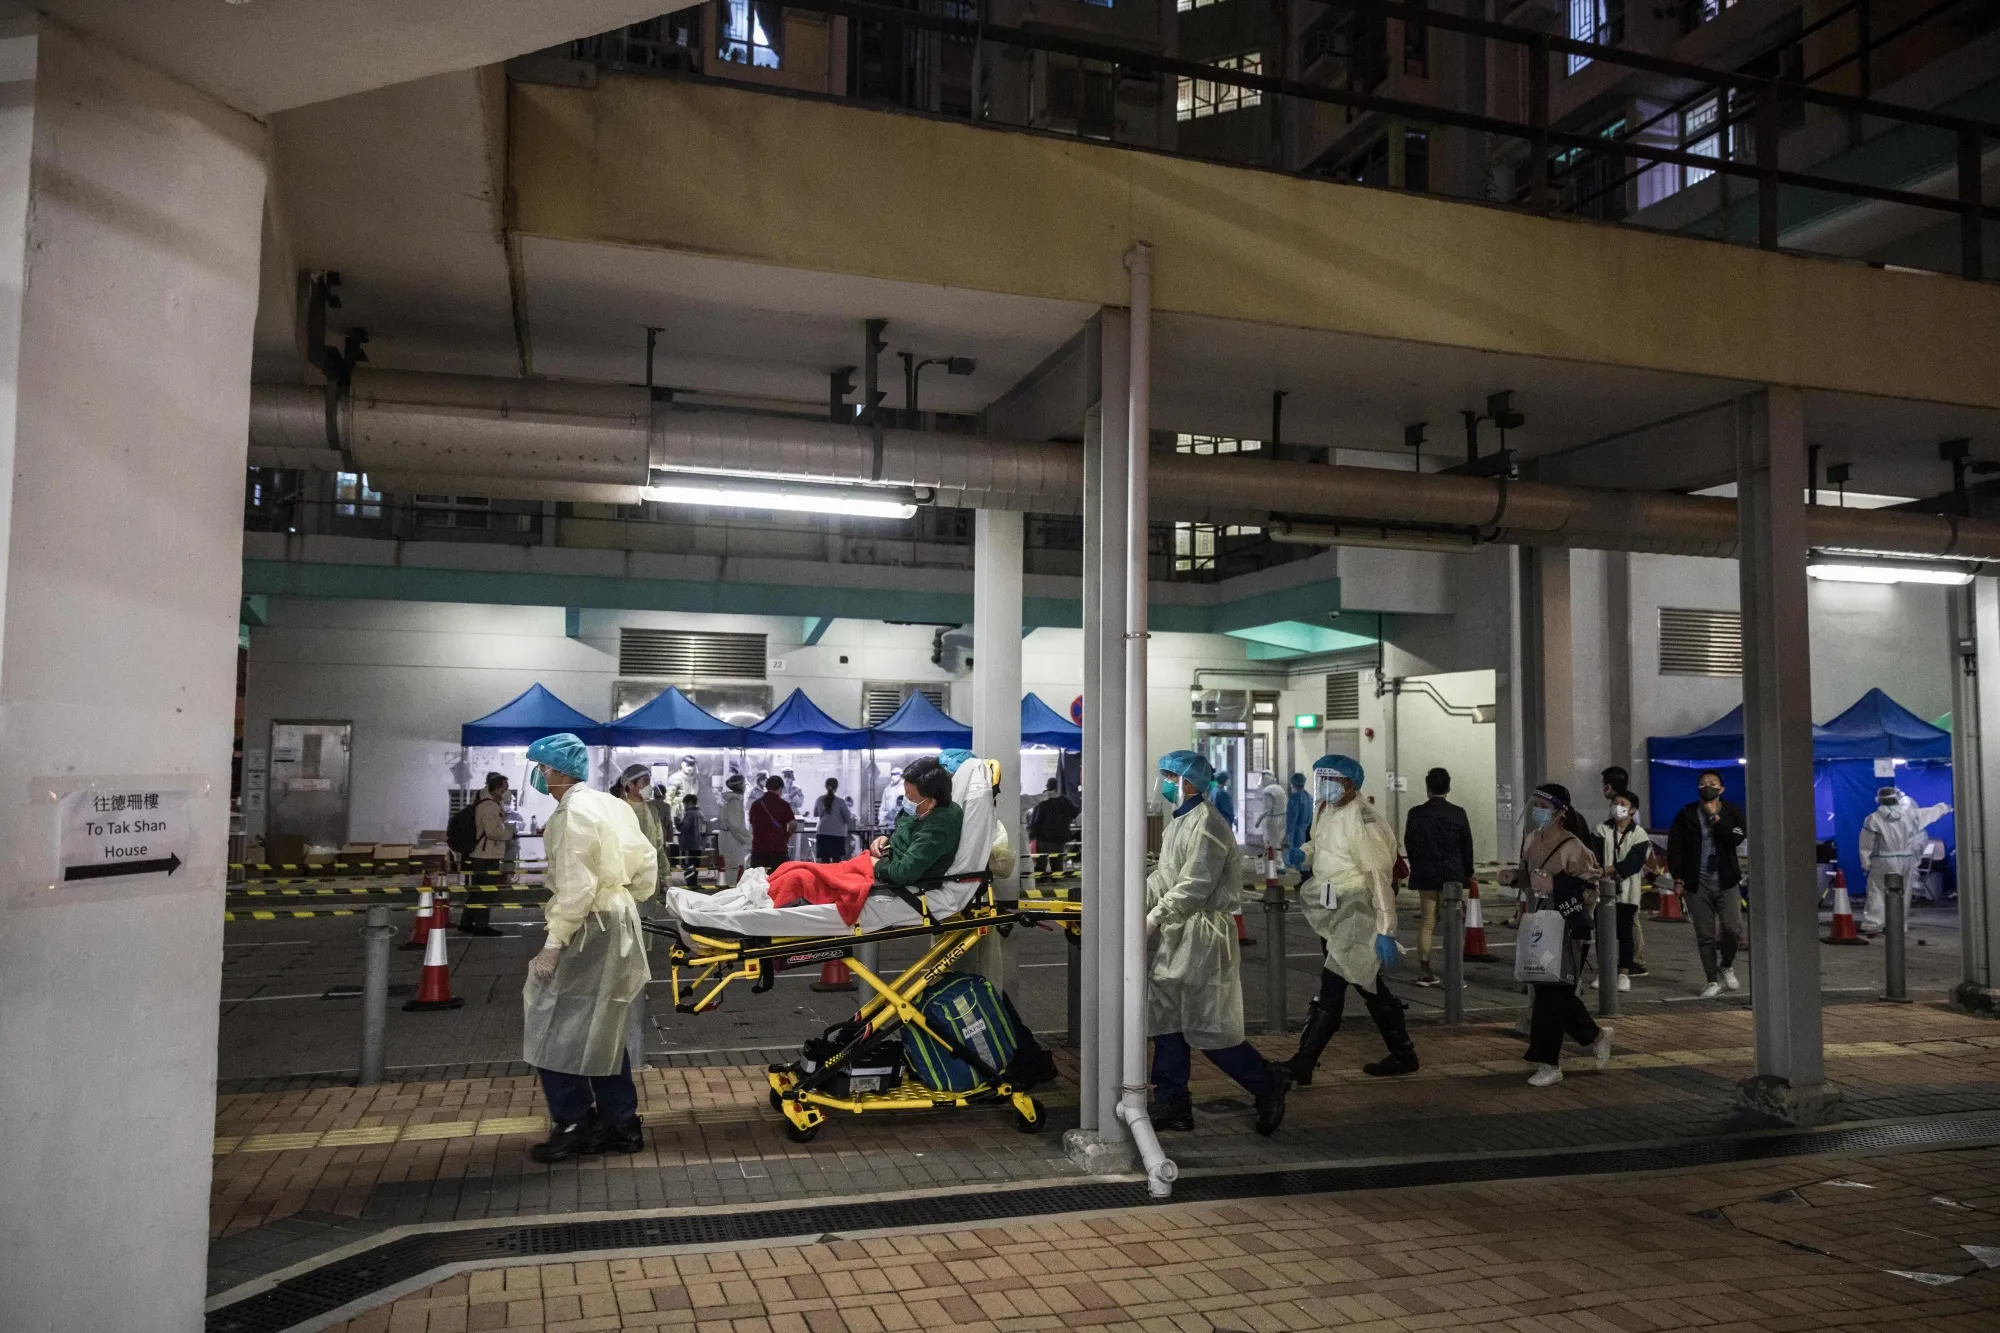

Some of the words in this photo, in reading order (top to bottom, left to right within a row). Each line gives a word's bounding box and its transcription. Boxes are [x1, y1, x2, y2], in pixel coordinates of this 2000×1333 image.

[772, 660, 783, 669] 22
[93, 793, 159, 813] 往德珊樓
[86, 822, 103, 836] To
[107, 821, 130, 835] Tak
[134, 820, 167, 833] Shan
[105, 845, 148, 858] House
[924, 942, 966, 984] stryker
